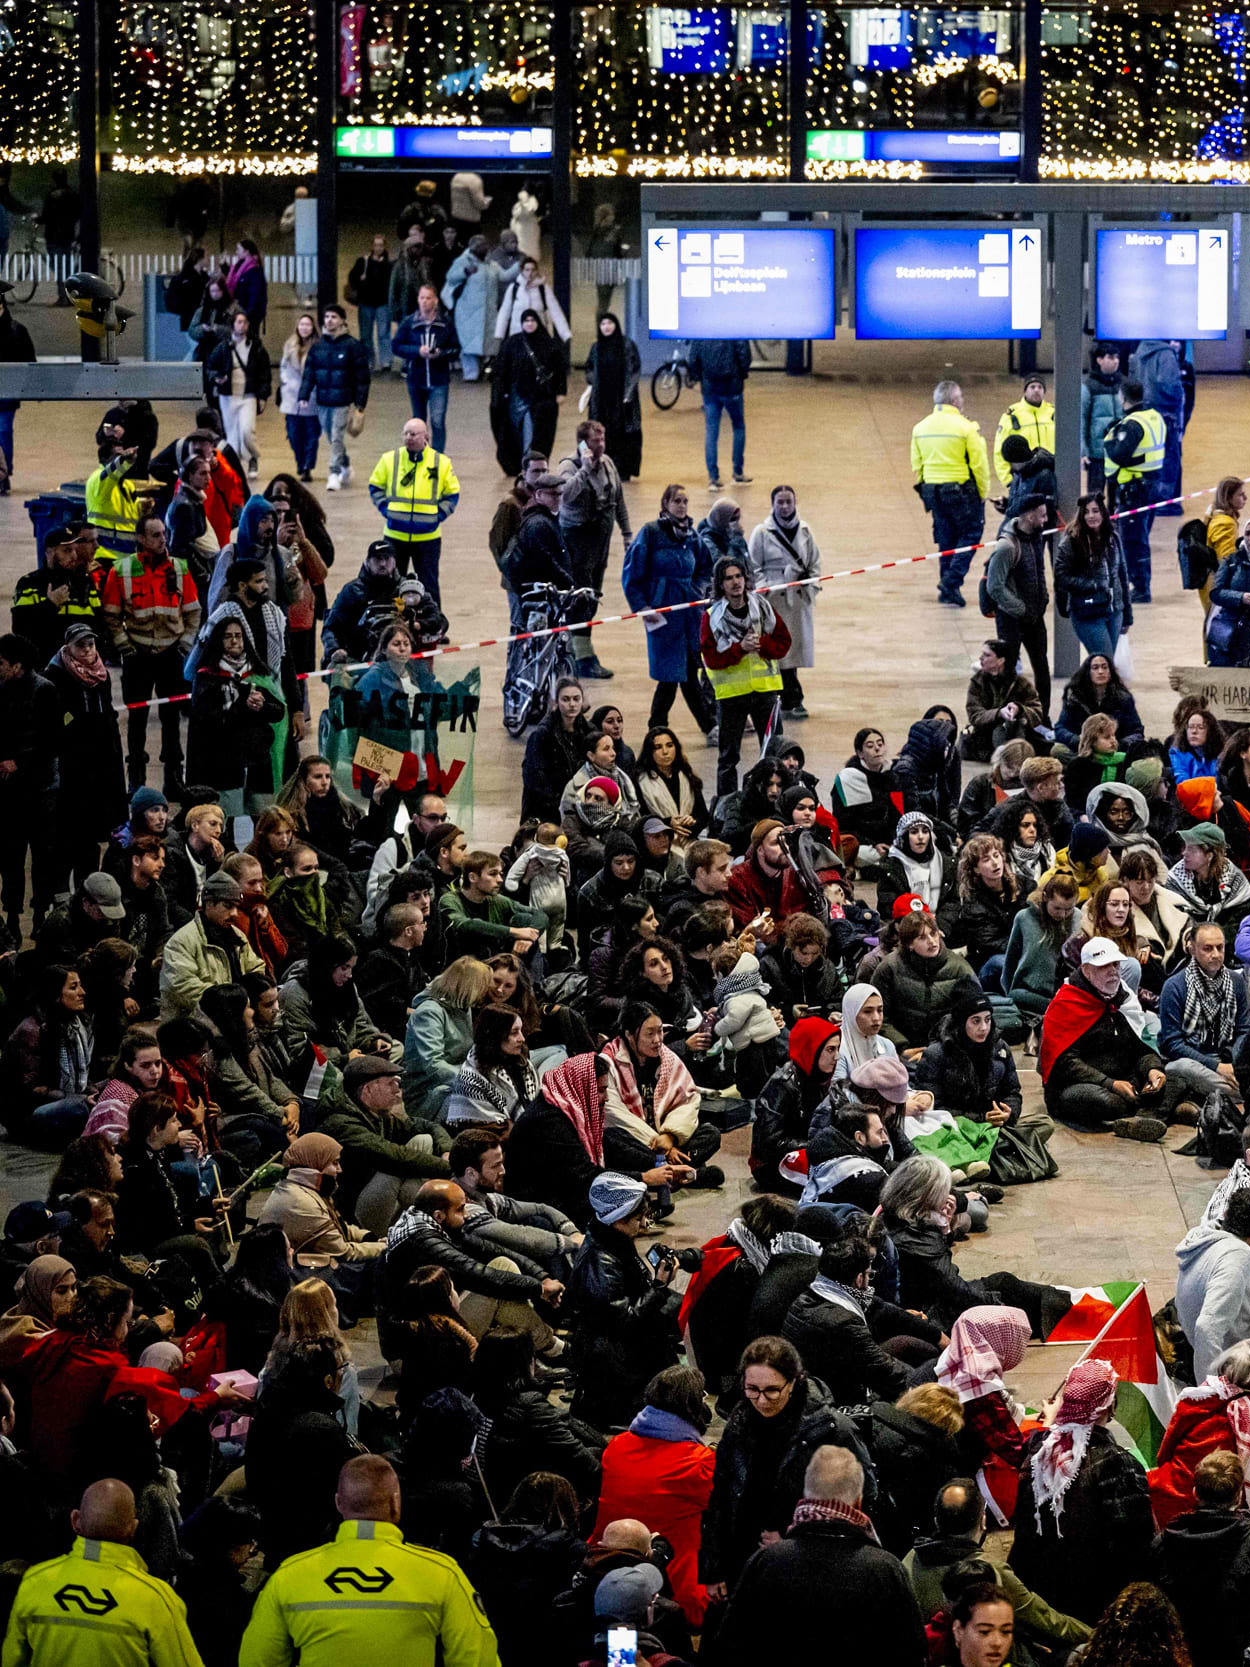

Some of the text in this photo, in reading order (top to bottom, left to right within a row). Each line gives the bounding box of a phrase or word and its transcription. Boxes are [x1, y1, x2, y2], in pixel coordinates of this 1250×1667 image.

[1126, 234, 1164, 245] Metro
[713, 266, 788, 281] Delftseplein
[896, 266, 977, 281] Stationsplein
[713, 280, 767, 295] Lijnbaan
